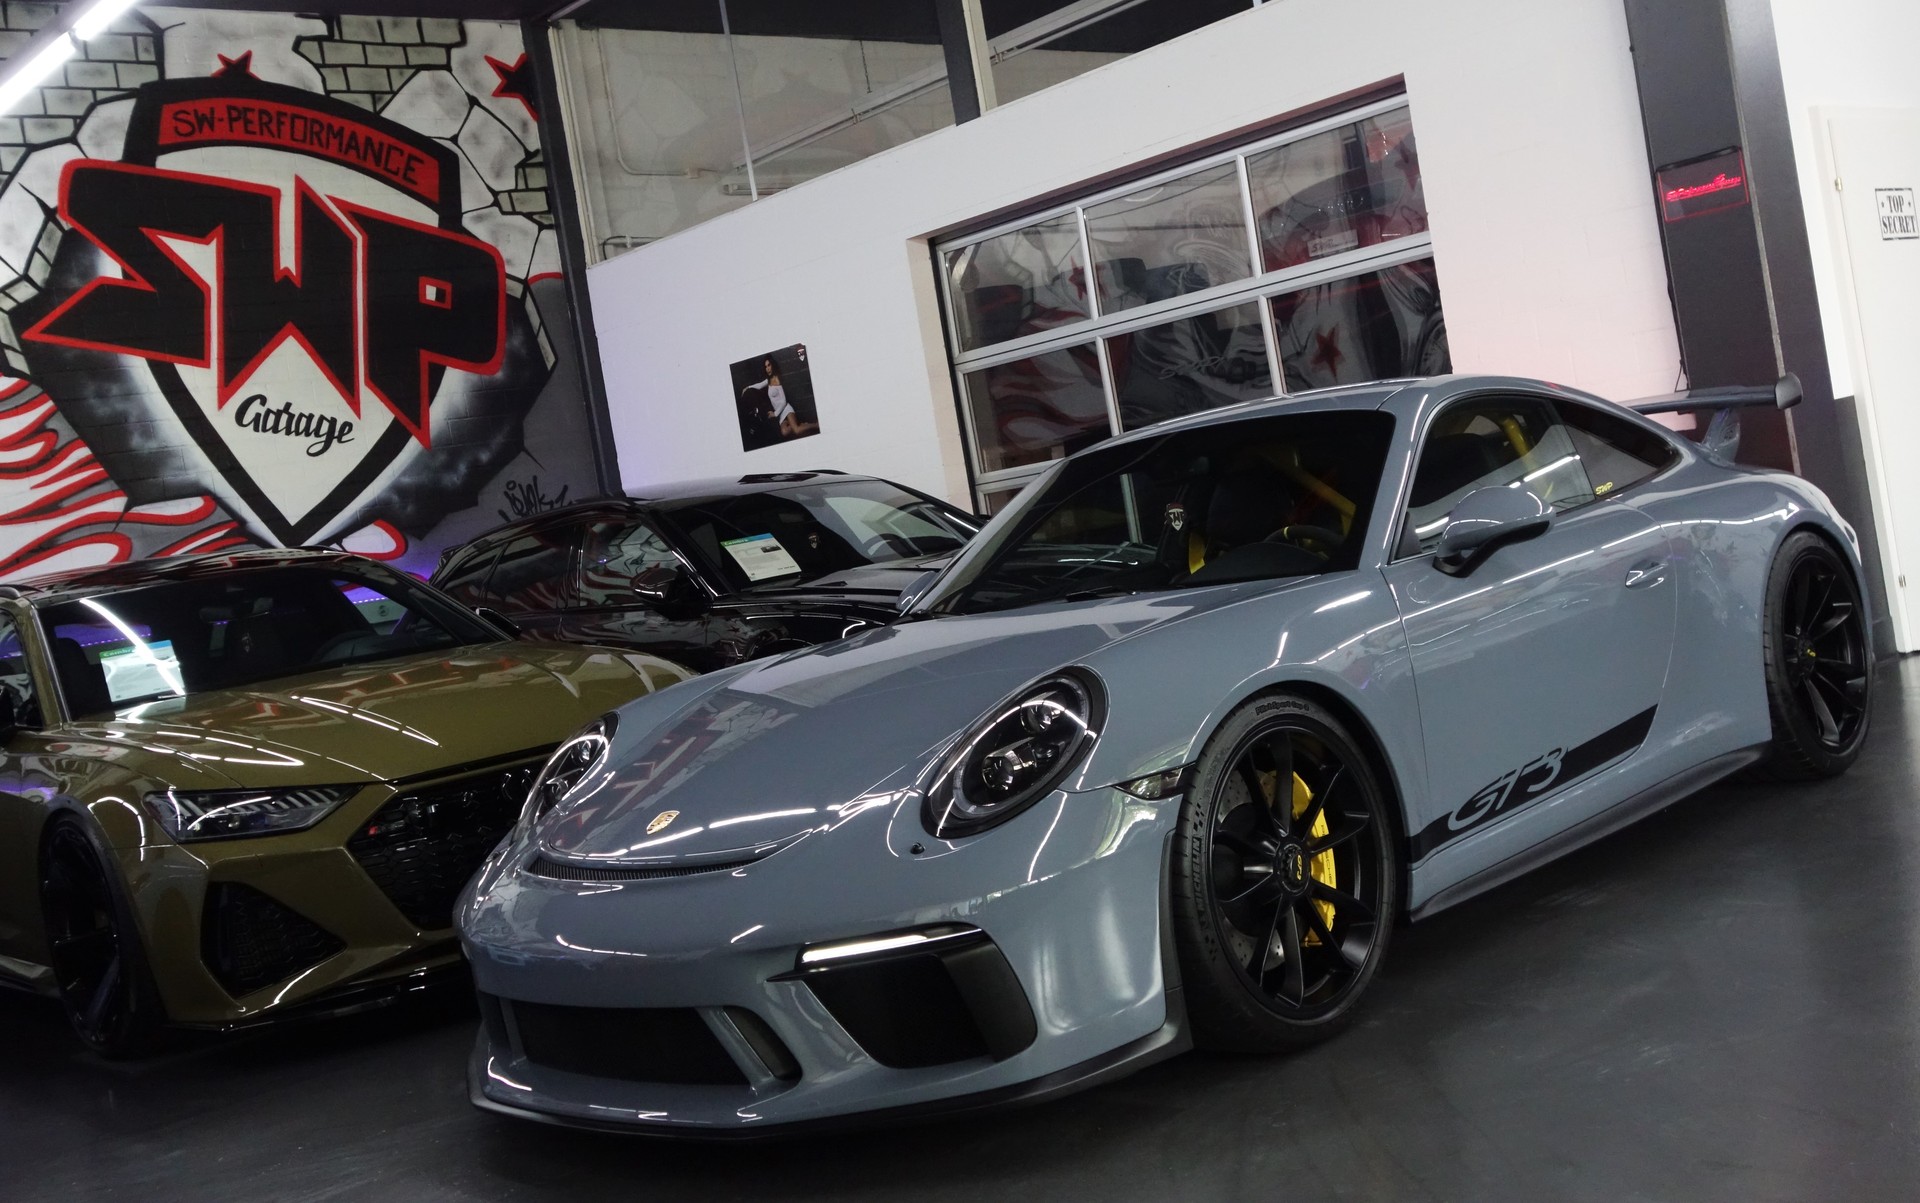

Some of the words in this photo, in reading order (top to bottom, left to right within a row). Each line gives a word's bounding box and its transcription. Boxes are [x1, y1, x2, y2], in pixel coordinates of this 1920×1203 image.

[172, 104, 425, 187] SW-PERFORMANCE
[1881, 215, 1916, 234] SECRET
[1886, 195, 1904, 213] TOP
[20, 158, 507, 450] SWP
[234, 393, 355, 458] Garage
[1595, 481, 1613, 495] SWP
[1447, 746, 1567, 831] GT3
